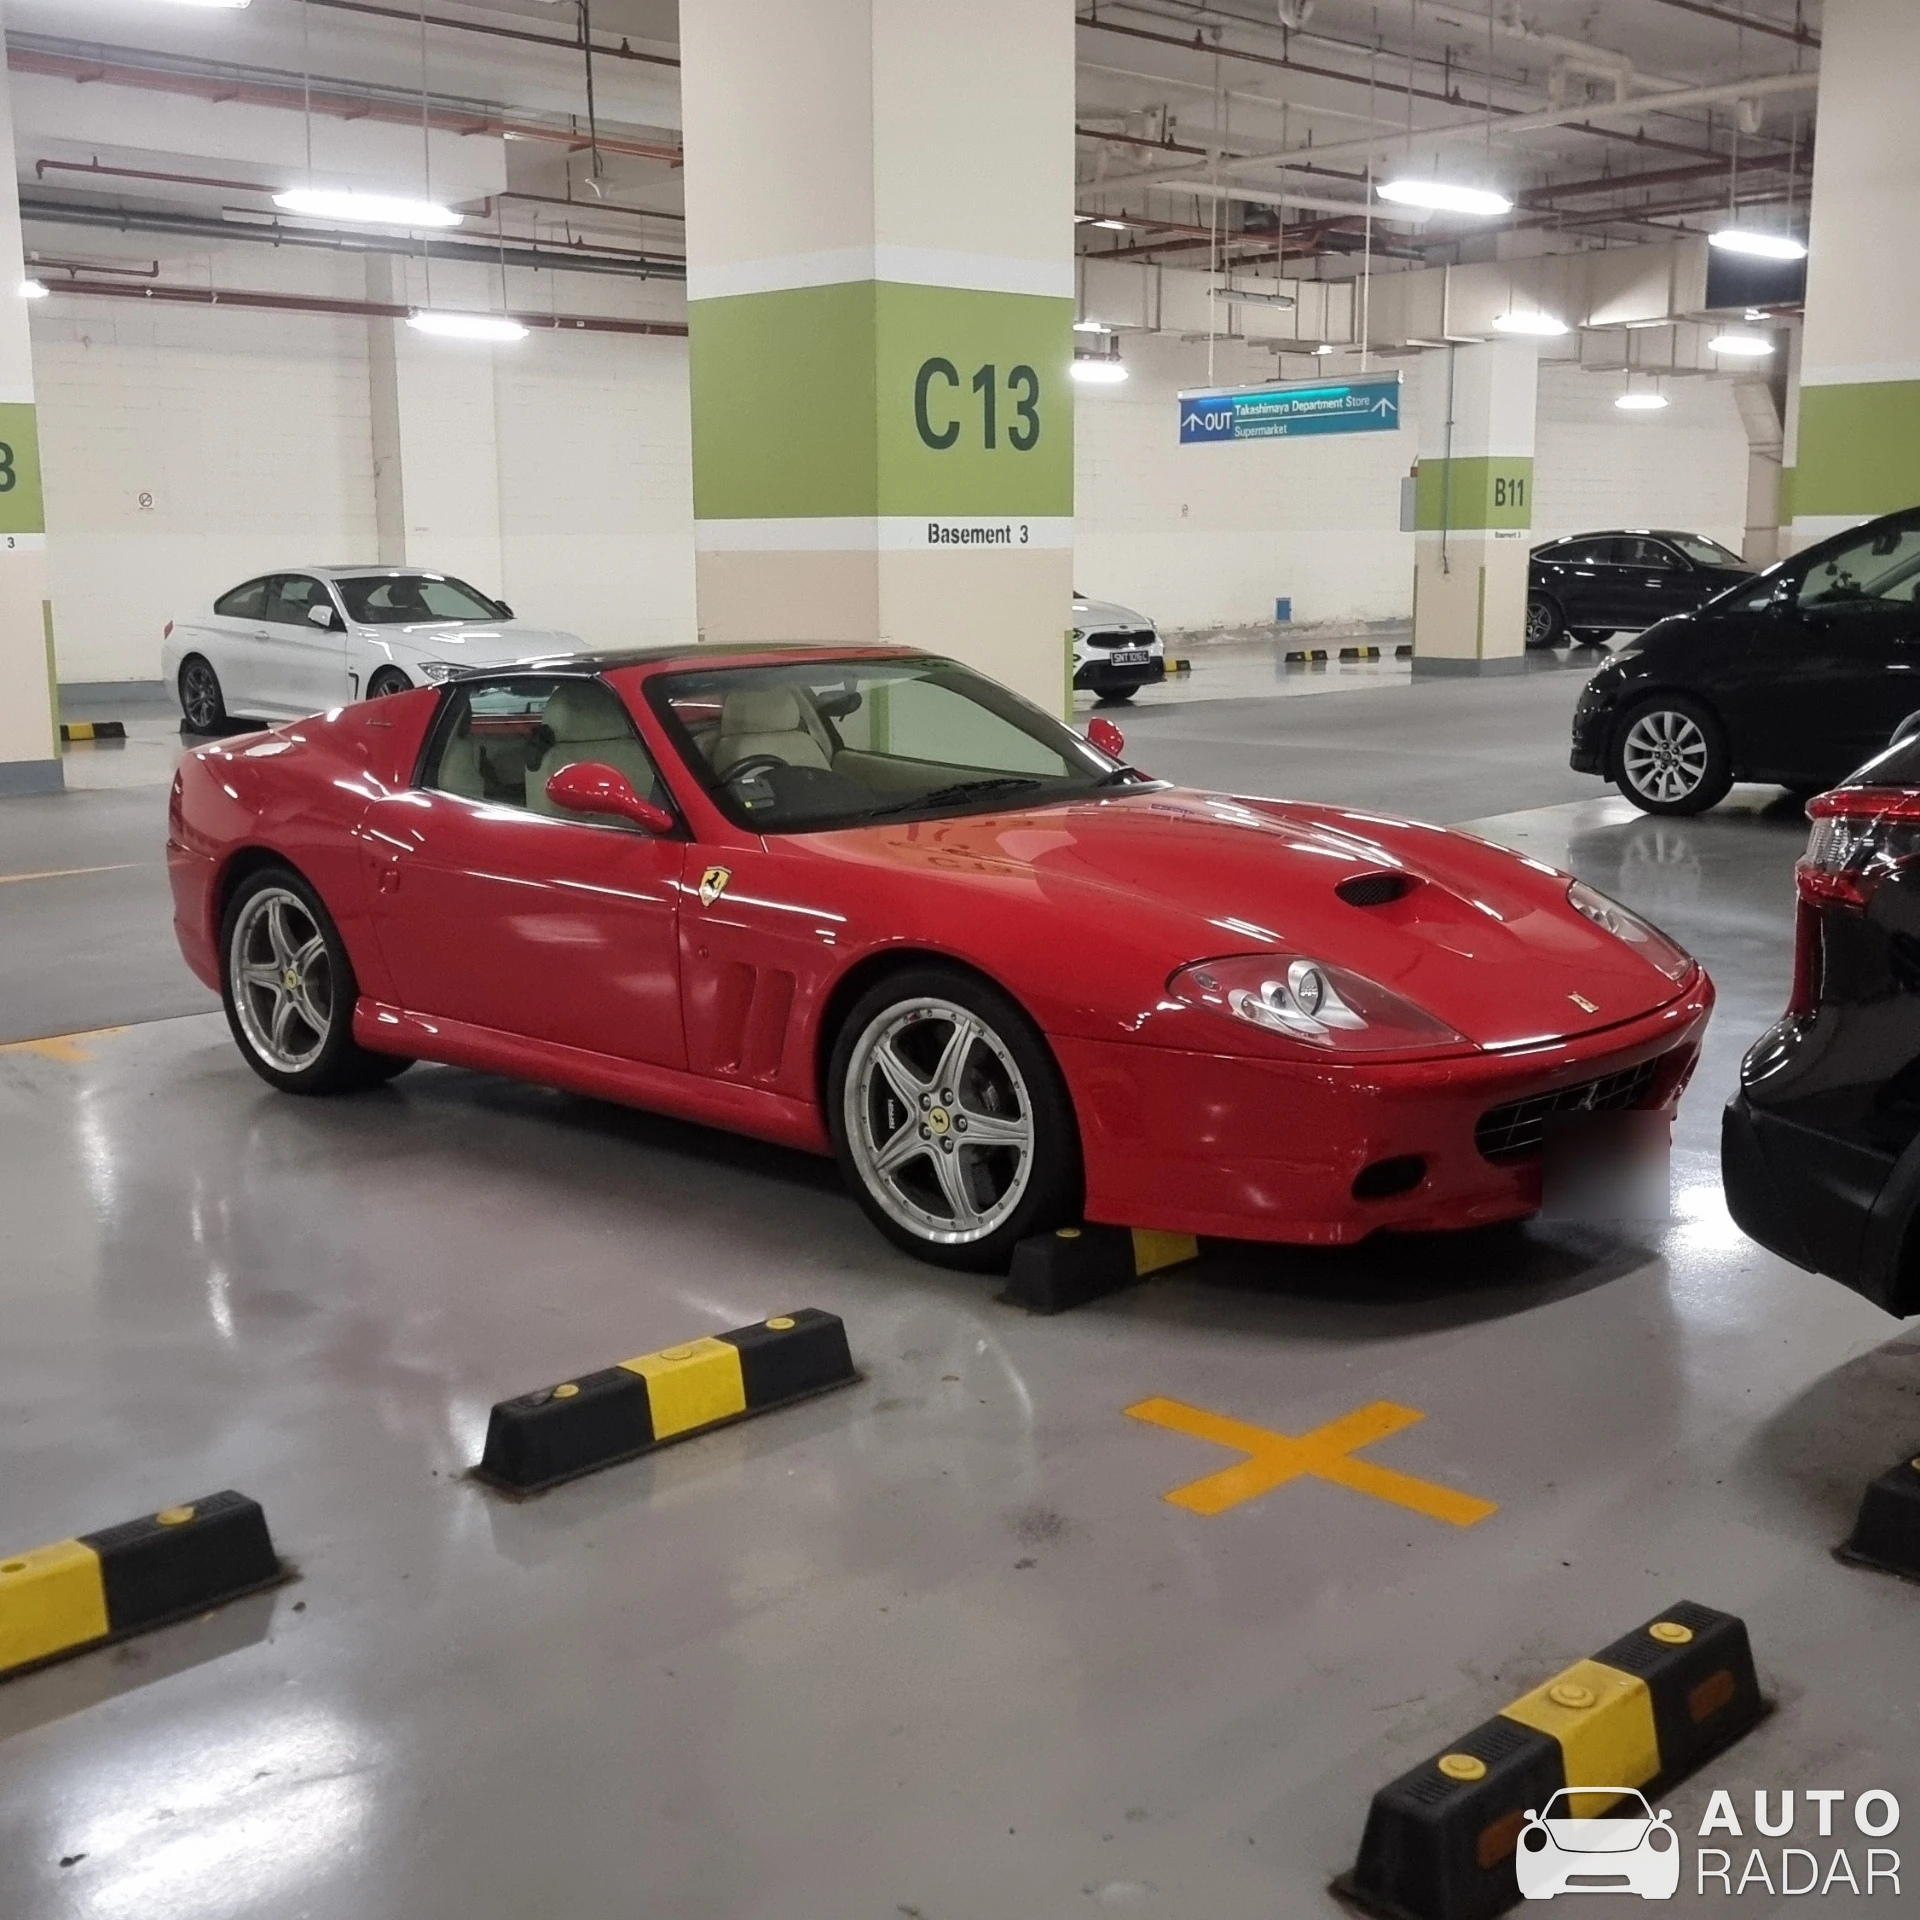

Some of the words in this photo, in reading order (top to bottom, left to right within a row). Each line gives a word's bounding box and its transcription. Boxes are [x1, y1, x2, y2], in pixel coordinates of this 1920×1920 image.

[914, 357, 1040, 451] C13
[1235, 404, 1290, 416] Takashimaya
[1292, 399, 1343, 414] Department
[1345, 395, 1370, 408] Store
[1204, 411, 1233, 431] OUT
[1234, 424, 1288, 438] Supermarket
[1494, 477, 1524, 507] B11
[7, 536, 15, 549] 3
[927, 522, 1012, 544] Basement
[1019, 524, 1029, 543] 3
